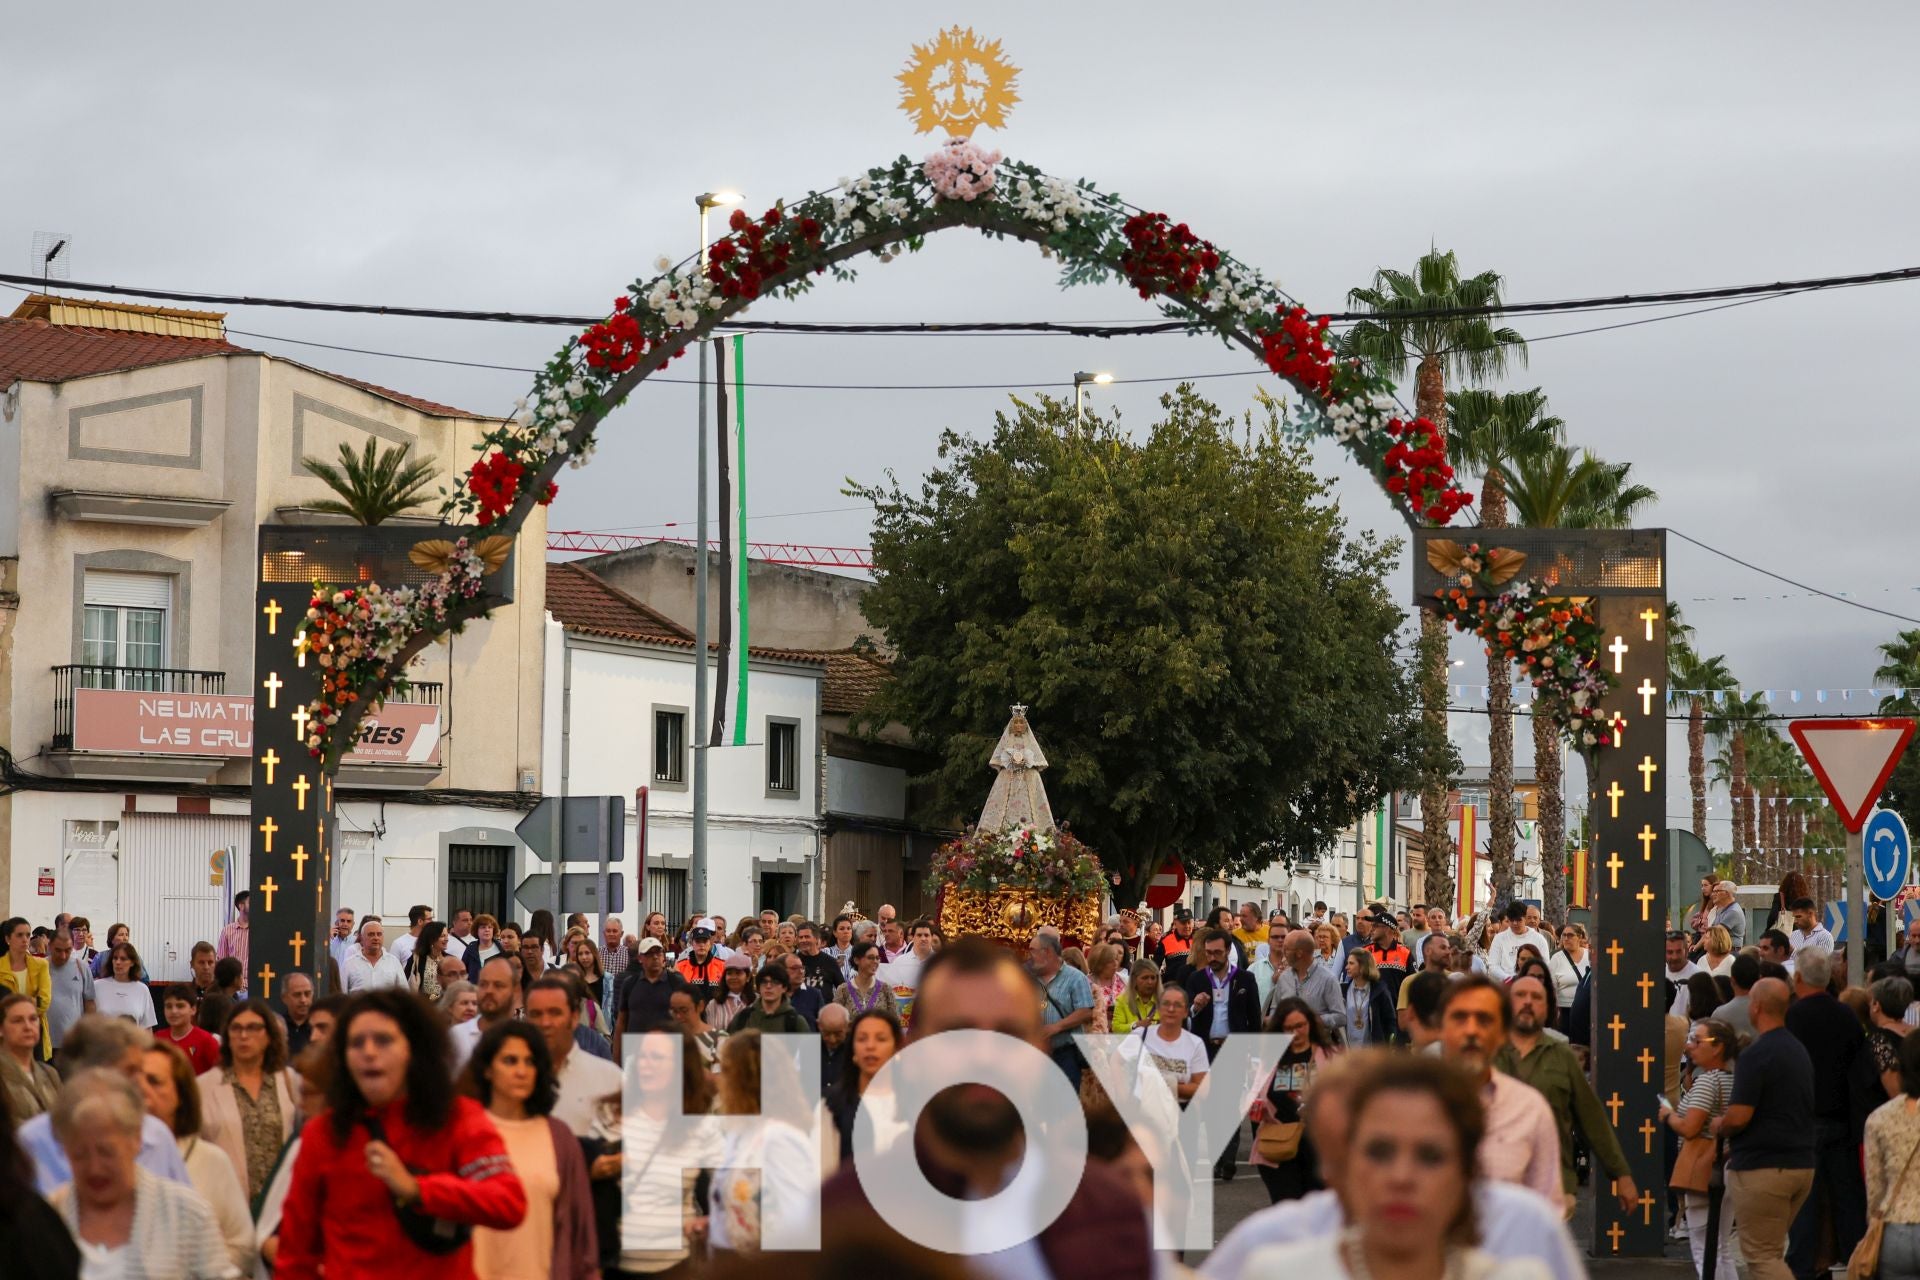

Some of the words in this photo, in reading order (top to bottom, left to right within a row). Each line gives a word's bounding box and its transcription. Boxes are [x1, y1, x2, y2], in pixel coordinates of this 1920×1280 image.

[139, 726, 191, 745] LAS
[201, 728, 253, 748] CRU
[358, 726, 405, 745] RES
